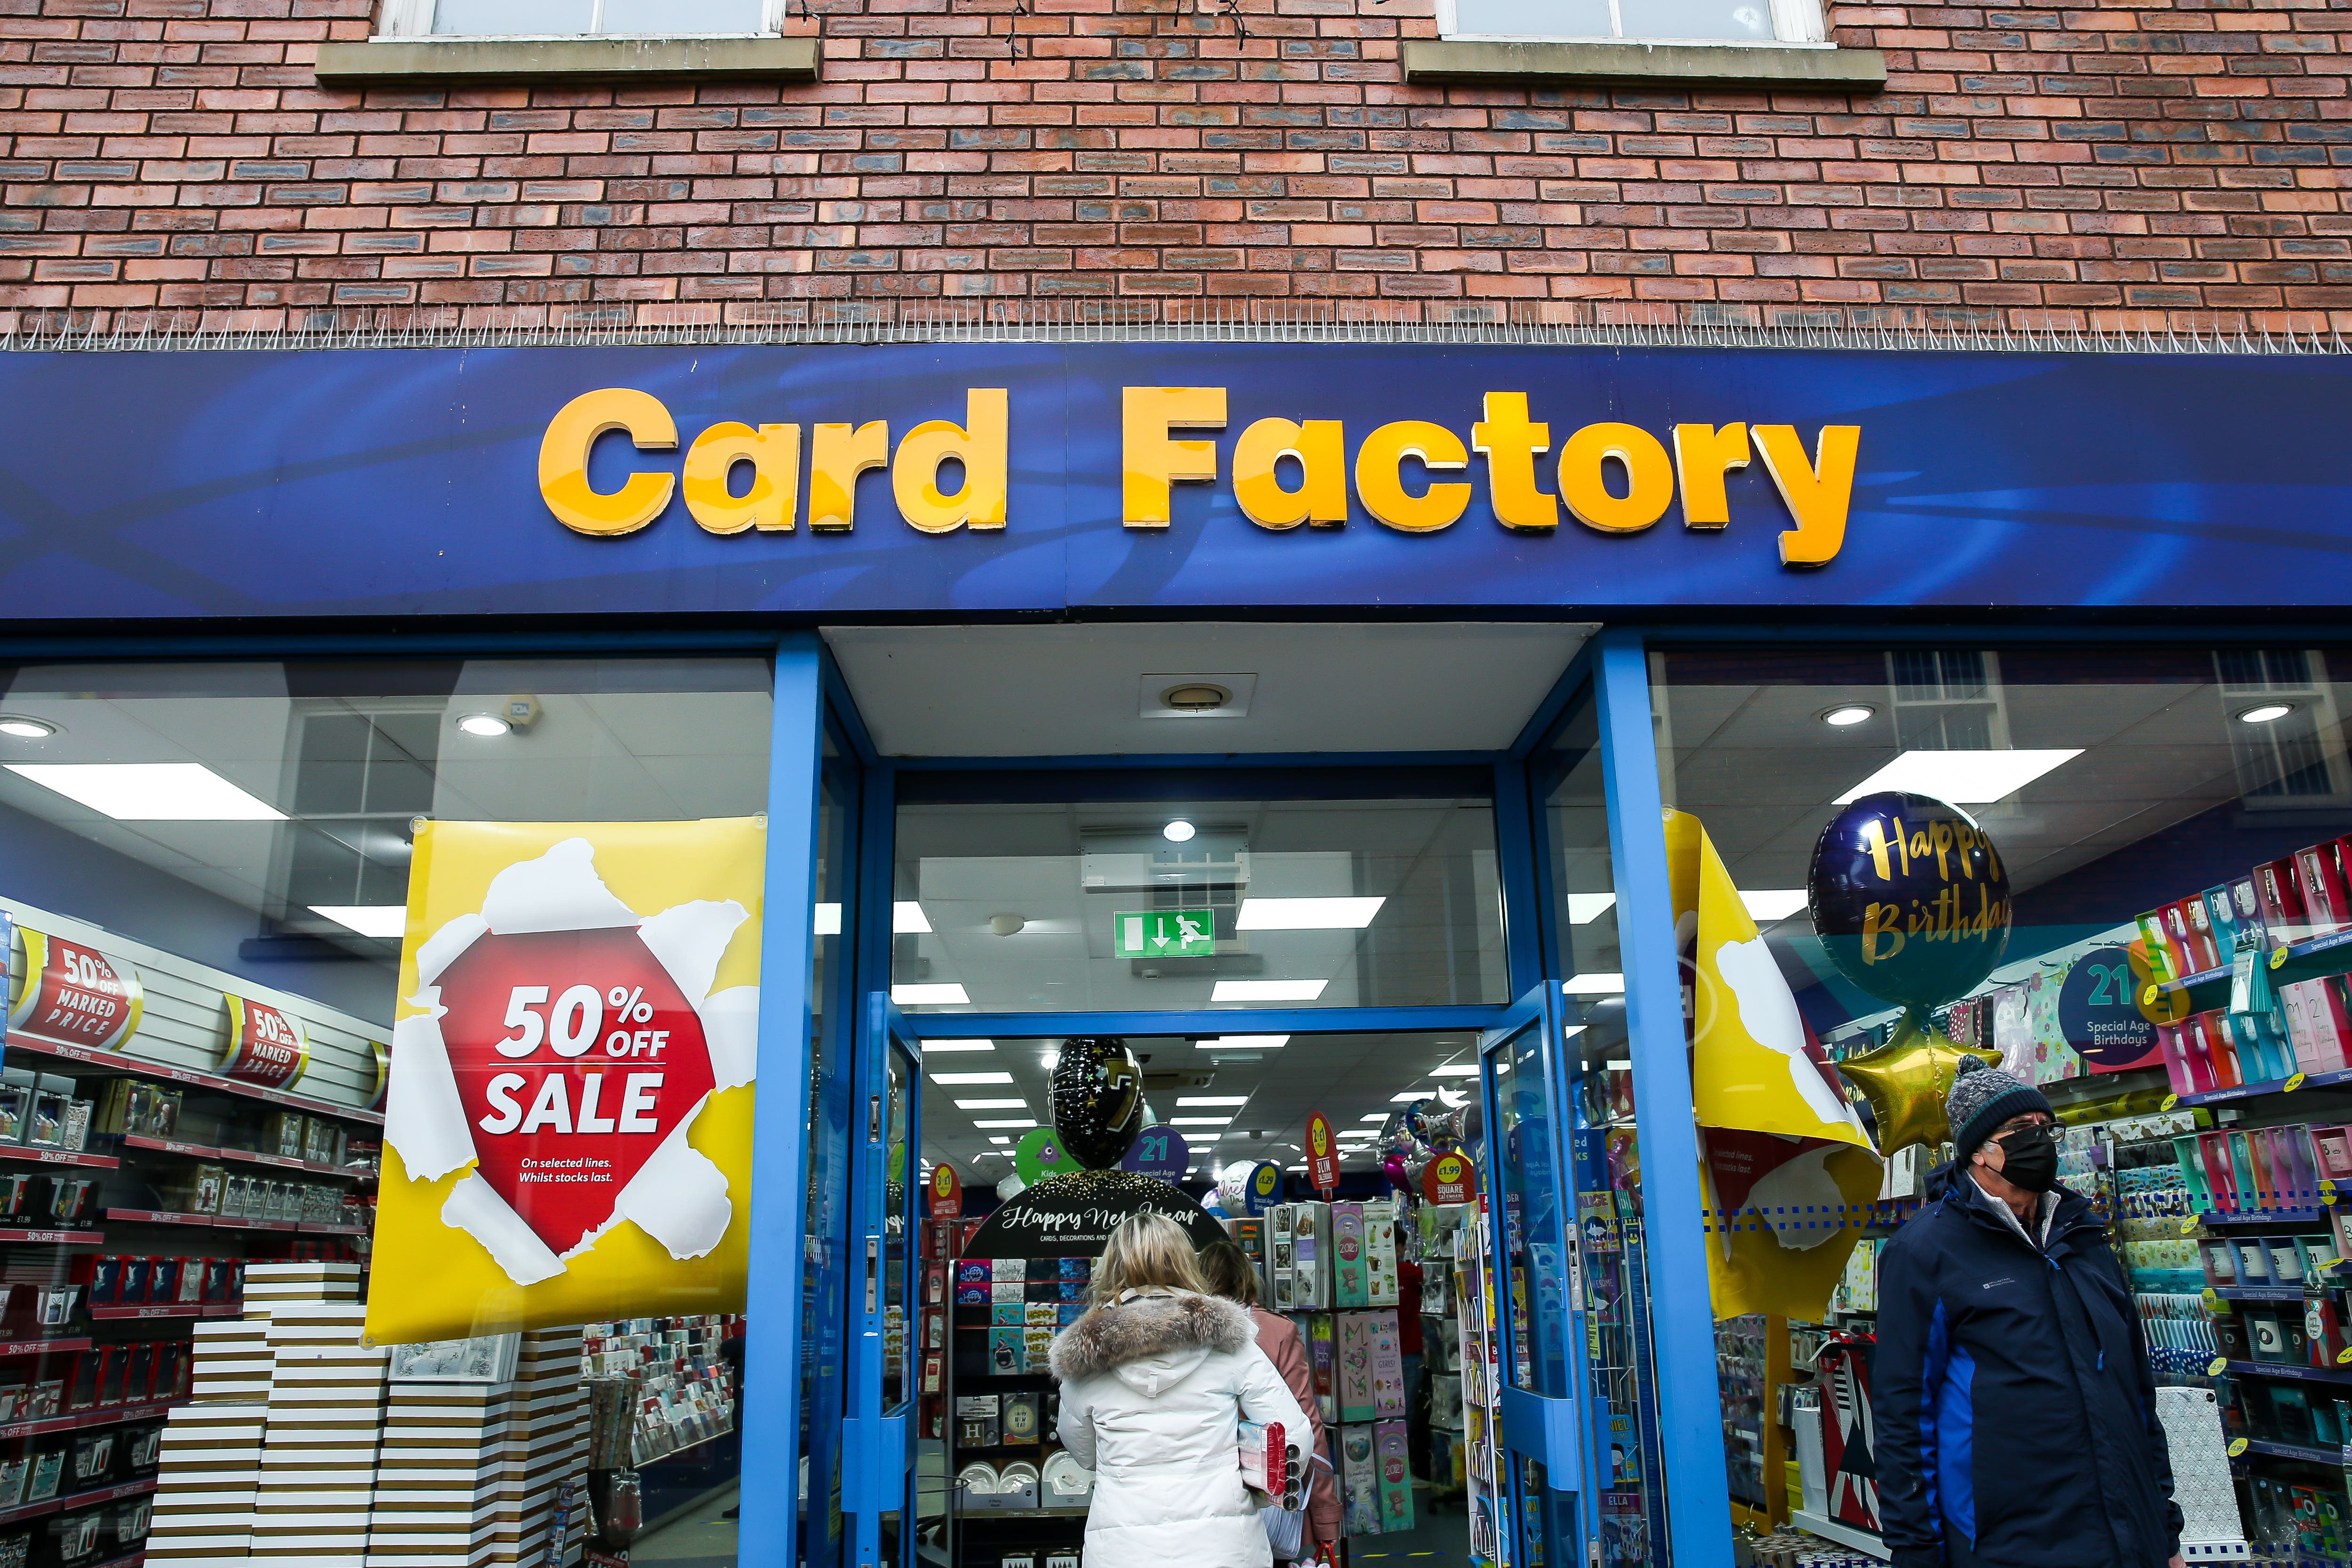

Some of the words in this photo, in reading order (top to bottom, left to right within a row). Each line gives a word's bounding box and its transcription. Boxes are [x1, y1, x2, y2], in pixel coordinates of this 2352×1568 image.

[538, 387, 1009, 536] Card
[1122, 386, 1861, 568] Factory
[1867, 816, 1999, 882] Happy
[2311, 940, 2328, 951] Special
[2338, 933, 2352, 942] Birth
[62, 948, 112, 989] 50%
[99, 979, 118, 996] OFF
[2087, 964, 2131, 1005] 21
[2184, 977, 2197, 986] Special
[56, 988, 116, 1018] MARKED
[2309, 997, 2325, 1018] 21
[2286, 1002, 2302, 1023] 21
[45, 1008, 110, 1036] PRICE
[253, 1008, 288, 1042] 50%
[495, 985, 654, 1058] 50%
[2087, 1020, 2126, 1034] Special
[2130, 1020, 2150, 1033] Age
[279, 1032, 293, 1046] OFF
[606, 1031, 670, 1057] OFF
[2094, 1034, 2147, 1047] Birthdays
[55, 1045, 69, 1056] 50%
[70, 1049, 81, 1058] OFF
[252, 1042, 292, 1064] MARKED
[244, 1058, 287, 1078] PRICE
[478, 1072, 664, 1134] SALE
[2204, 1092, 2218, 1101] Special
[1139, 1136, 1168, 1161] 21
[1736, 1150, 1753, 1161] lines.
[40, 1151, 55, 1160] 50%
[55, 1153, 67, 1162] OFF
[521, 1158, 538, 1169] On
[540, 1157, 584, 1169] selected
[586, 1158, 612, 1169] lines.
[1317, 1159, 1331, 1174] SLIM
[1438, 1166, 1460, 1175] £1.99
[1737, 1164, 1752, 1174] last.
[519, 1171, 553, 1183] Whilst
[555, 1171, 588, 1182] stocks
[591, 1171, 613, 1182] last.
[1259, 1175, 1273, 1185] £1.29
[1437, 1185, 1463, 1194] SQUARE
[1579, 1194, 1609, 1207] ALICE
[1002, 1206, 1081, 1231] Happy
[1084, 1208, 1126, 1229] Ne
[27, 1232, 41, 1241] 50%
[1339, 1243, 1358, 1253] 2021
[8, 1345, 23, 1353] 50%
[24, 1344, 37, 1352] OFF
[2340, 1349, 2352, 1358] £4.9
[2281, 1368, 2302, 1377] Birthdays
[8, 1427, 20, 1436] OFF
[965, 1424, 980, 1438] H
[2272, 1446, 2289, 1455] Special
[2289, 1448, 2298, 1457] Age
[2298, 1450, 2321, 1461] Birthdays
[1385, 1464, 1404, 1476] 2021
[125, 1486, 134, 1494] OFF
[1609, 1496, 1628, 1505] ELLA
